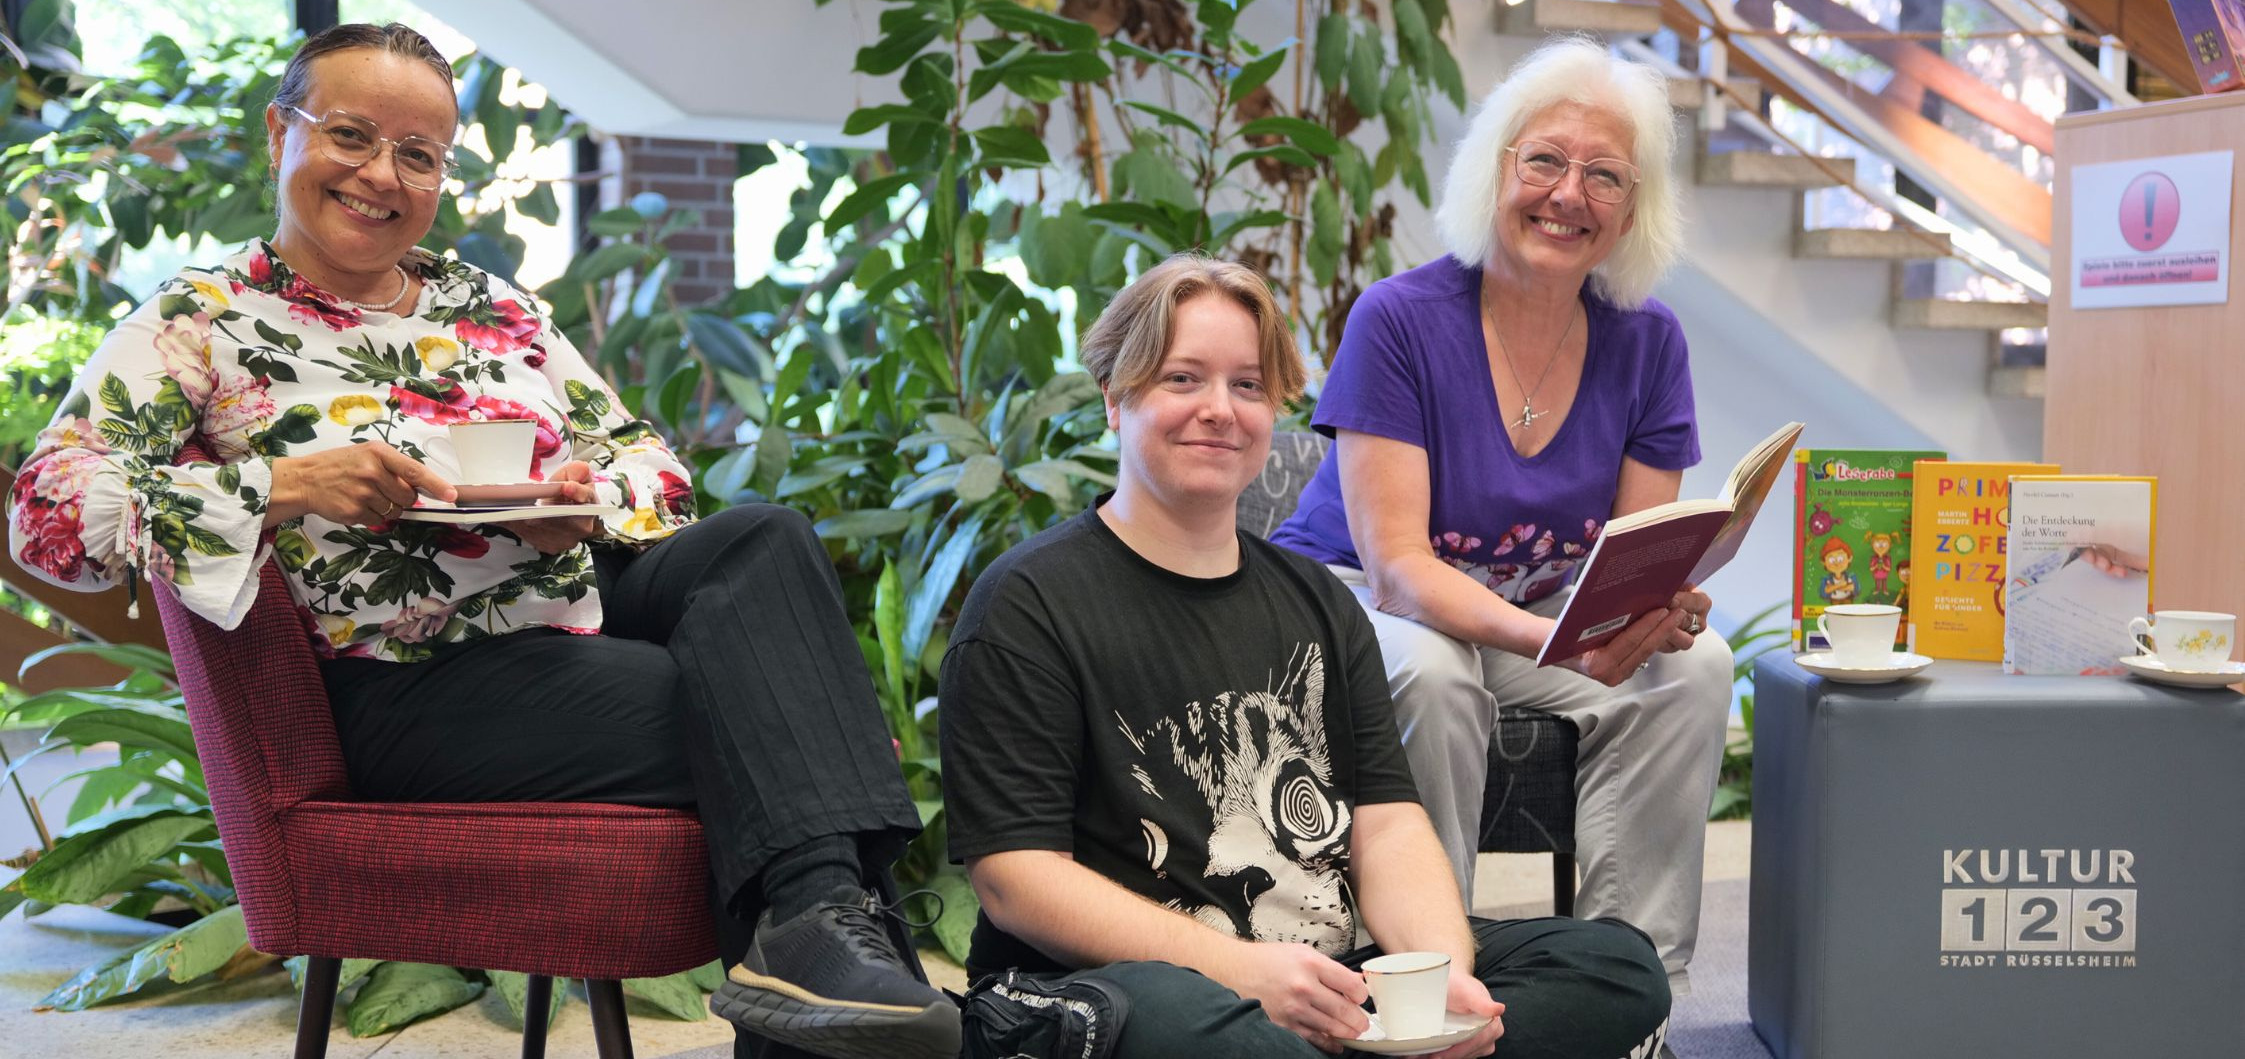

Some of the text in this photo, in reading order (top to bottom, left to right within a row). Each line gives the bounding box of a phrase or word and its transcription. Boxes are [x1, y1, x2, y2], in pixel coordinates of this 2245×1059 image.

[2113, 260, 2134, 269] bitte
[2103, 274, 2120, 283] und
[1837, 464, 1895, 481] Leserabe
[1817, 488, 1833, 497] Die
[2022, 515, 2096, 527] Die Entdeckung
[2021, 527, 2036, 538] der
[2039, 527, 2068, 538] Worte
[1943, 848, 2136, 884] KULTUR
[1940, 953, 2137, 968] STADT RÜSSELSHEIM
